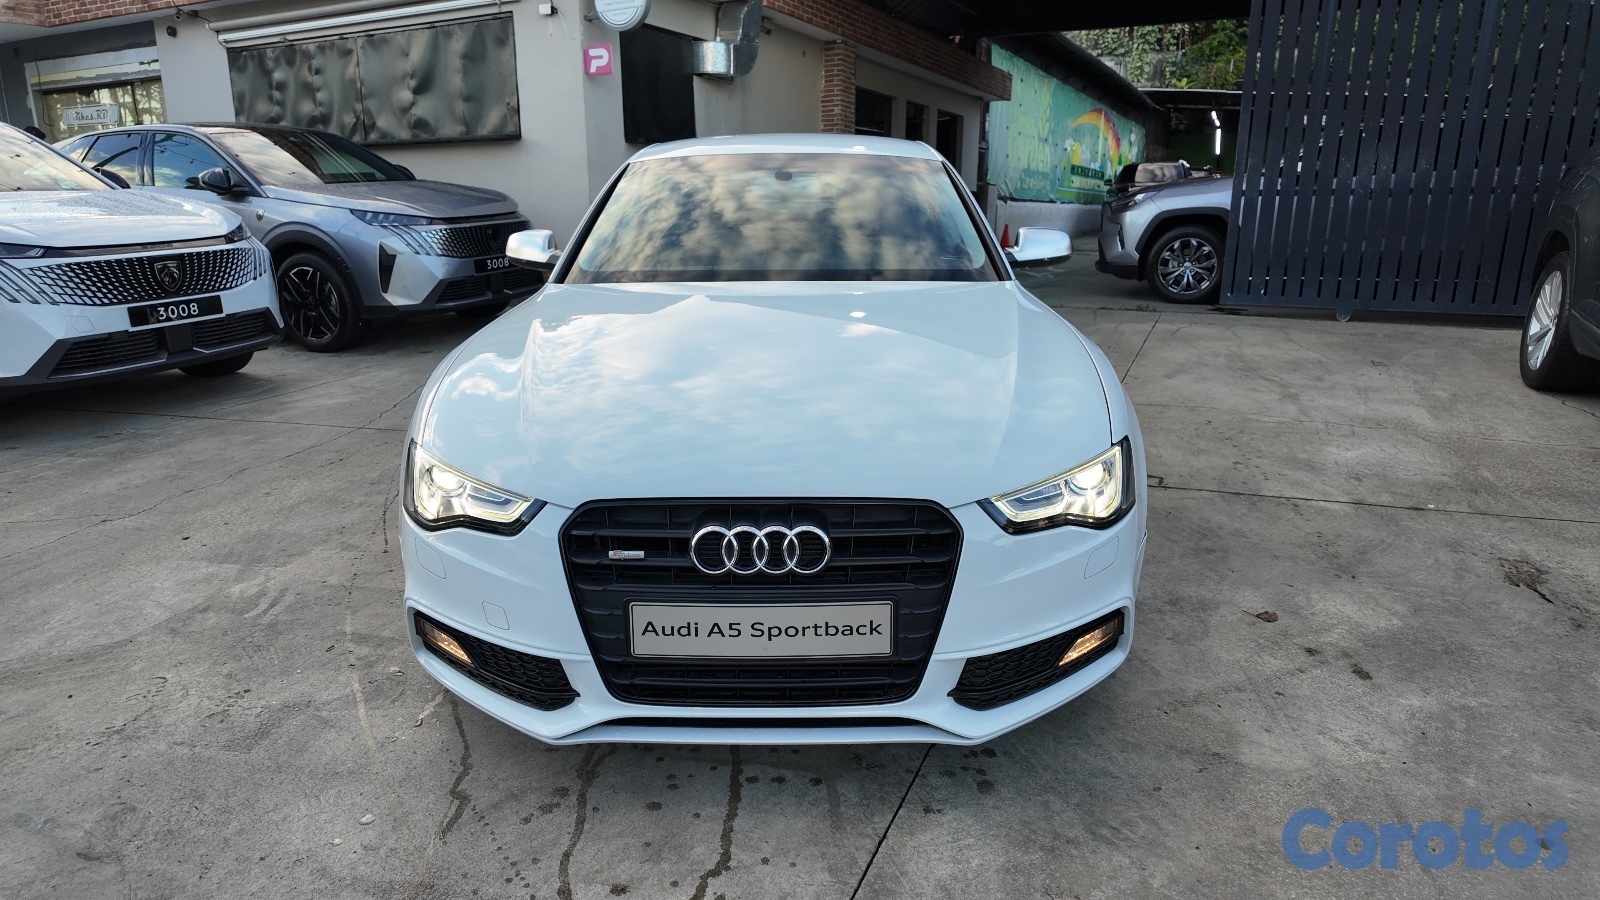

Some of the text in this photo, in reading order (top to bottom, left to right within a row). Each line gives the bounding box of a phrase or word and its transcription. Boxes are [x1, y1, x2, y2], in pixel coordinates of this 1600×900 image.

[588, 48, 609, 73] P
[486, 258, 510, 270] 3008
[157, 302, 199, 320] 3008
[641, 620, 883, 641] Audi A5 Sportback
